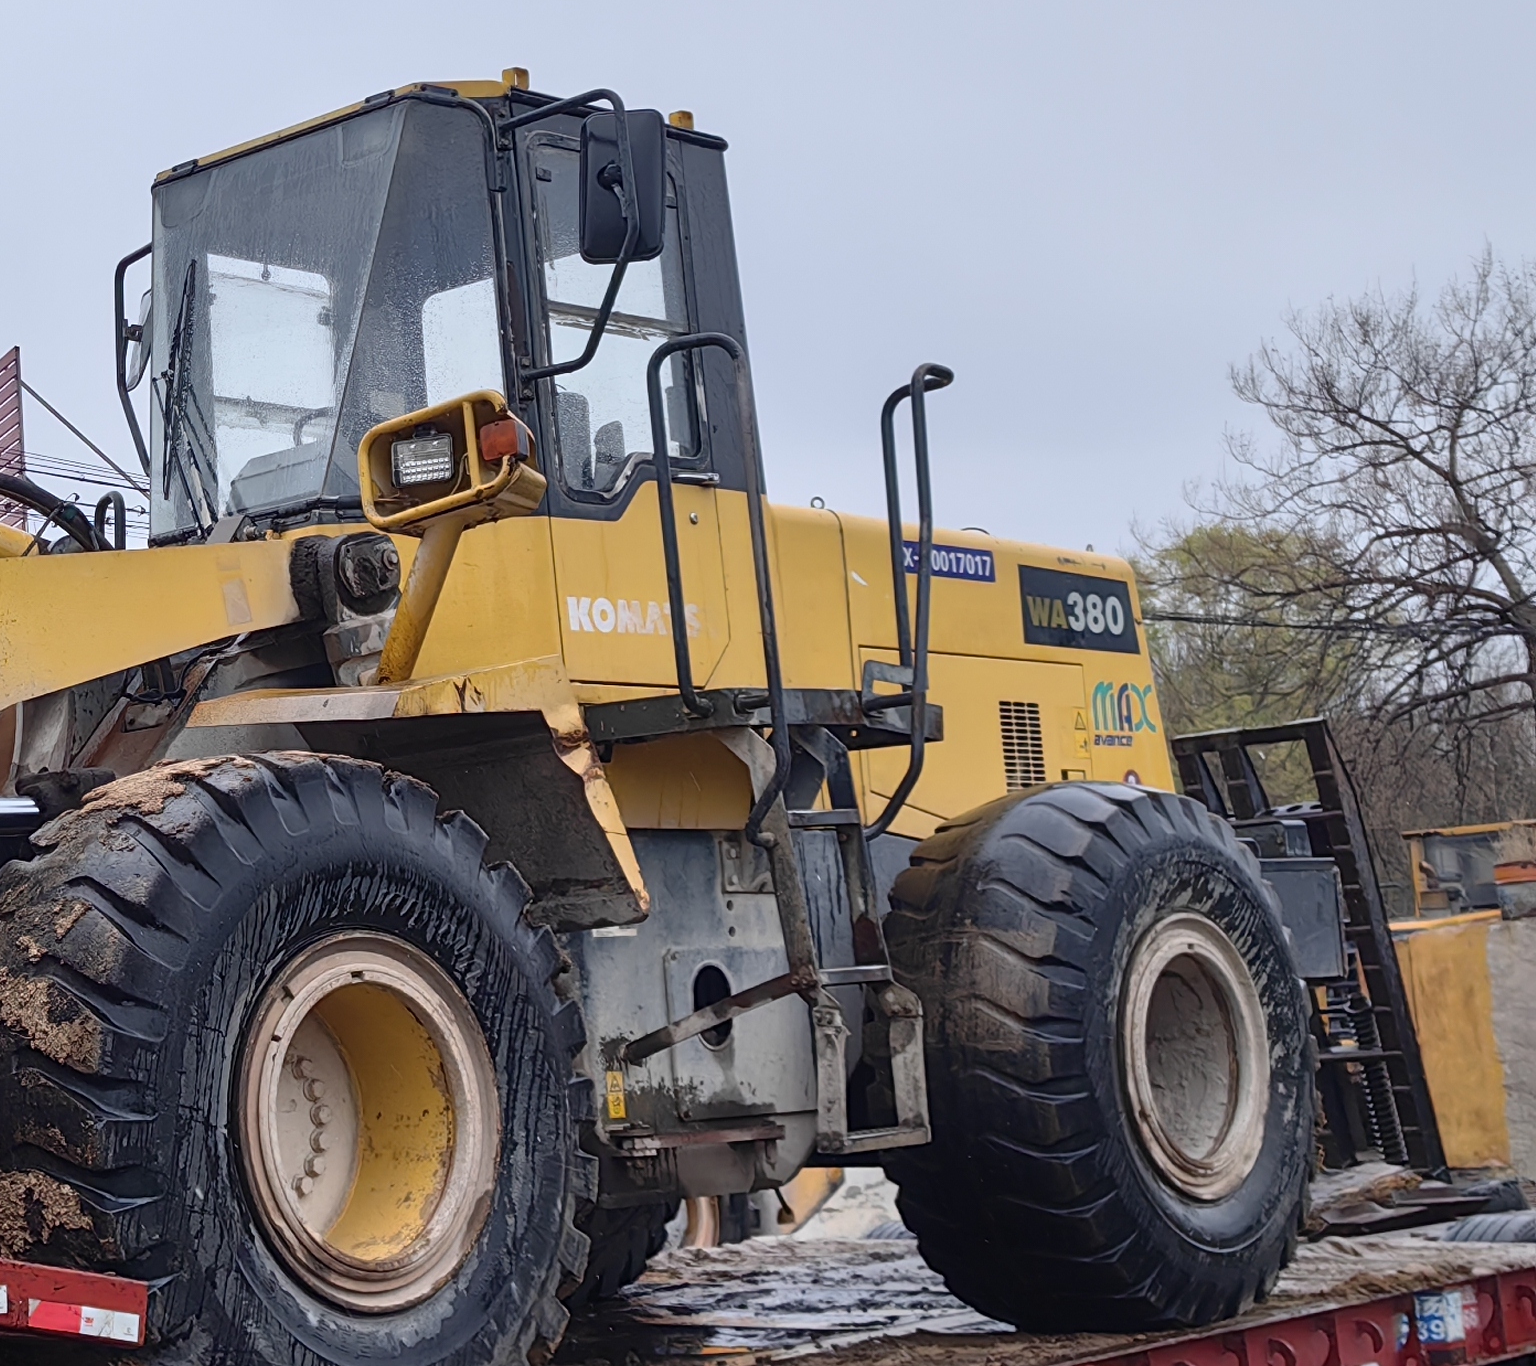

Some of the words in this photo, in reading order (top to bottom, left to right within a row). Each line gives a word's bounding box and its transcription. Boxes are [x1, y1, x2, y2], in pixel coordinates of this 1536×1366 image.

[902, 546, 992, 577] X-0017017
[1092, 681, 1157, 733] MAX
[1093, 734, 1133, 747] avance
